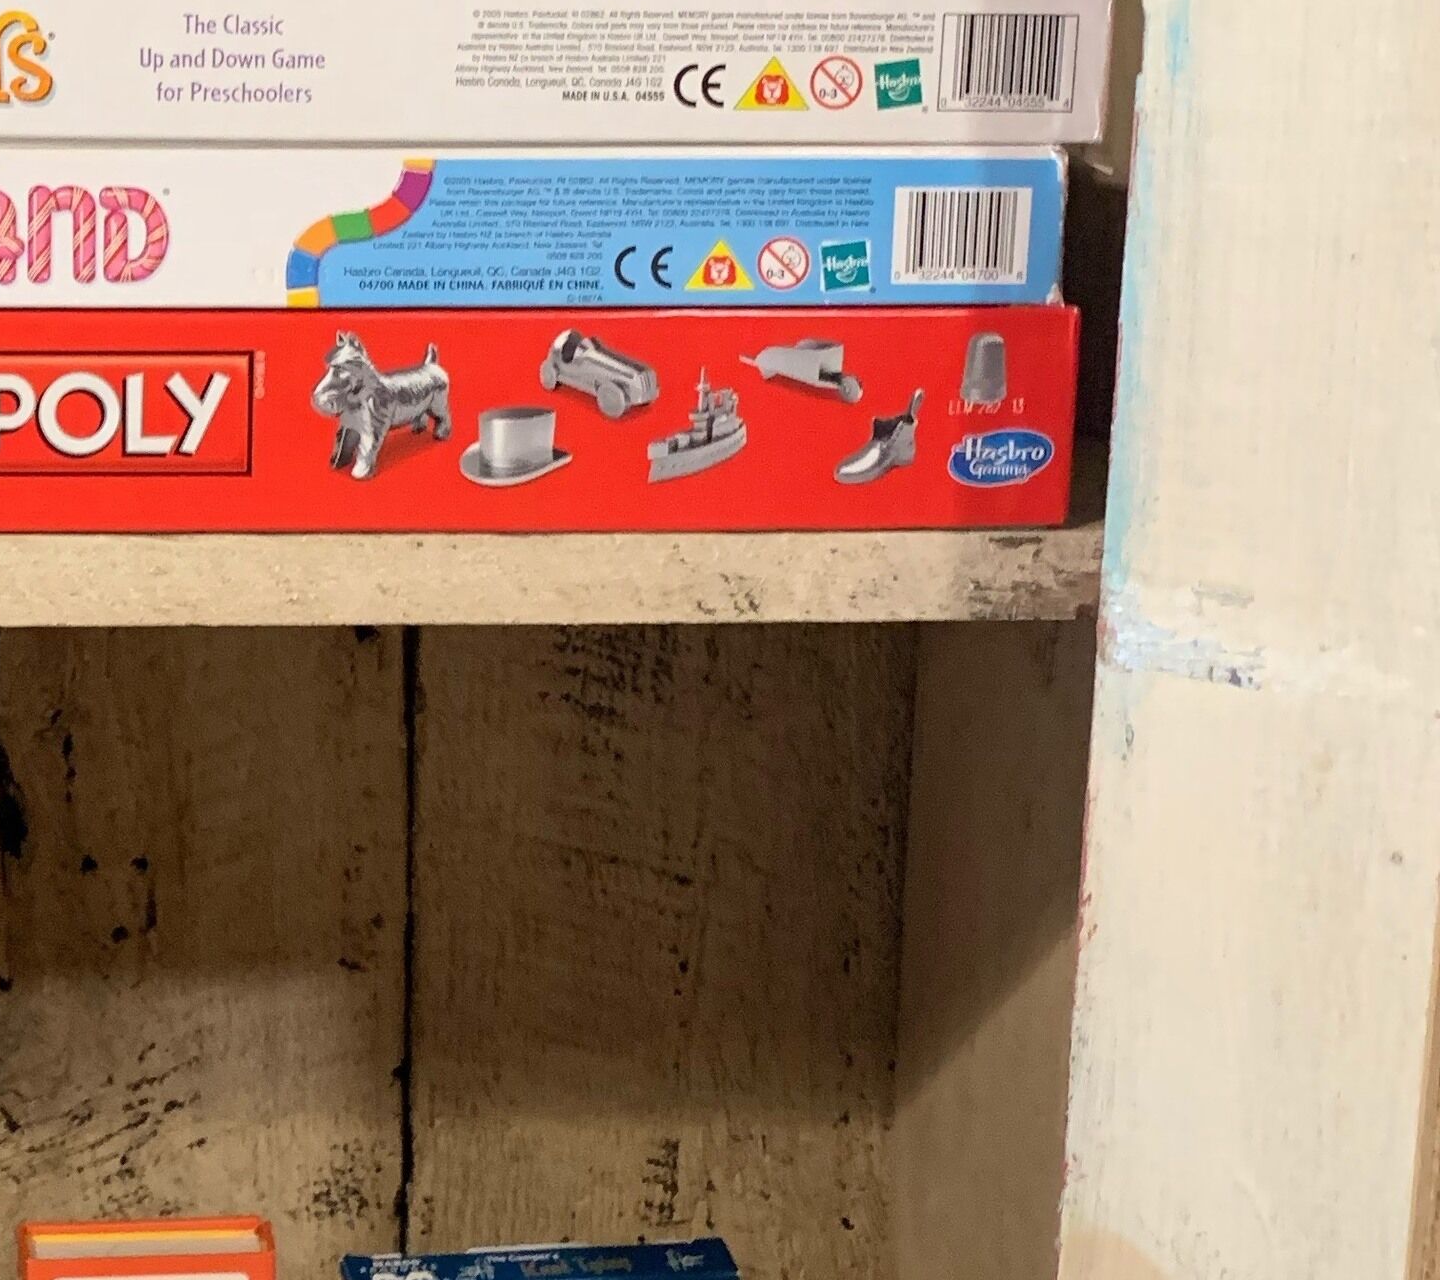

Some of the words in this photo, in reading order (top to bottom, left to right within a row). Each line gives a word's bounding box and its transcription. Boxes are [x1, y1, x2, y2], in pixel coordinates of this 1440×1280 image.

[183, 14, 217, 36] The
[223, 14, 285, 36] Classic
[139, 48, 164, 73] Up
[169, 47, 206, 70] and
[211, 47, 266, 70] Down
[272, 48, 326, 71] Game
[157, 81, 185, 102] for
[190, 81, 313, 104] Preschoolers
[562, 91, 588, 102] MADE
[590, 91, 601, 102] IN
[603, 91, 630, 102] U.S.A.
[818, 88, 838, 100] 0-3
[398, 279, 429, 291] MADE
[433, 279, 446, 291] IN
[549, 279, 564, 291] EN
[765, 268, 786, 281] 0-3
[964, 436, 1046, 466] Hasbro
[969, 458, 1028, 480] Gaming
